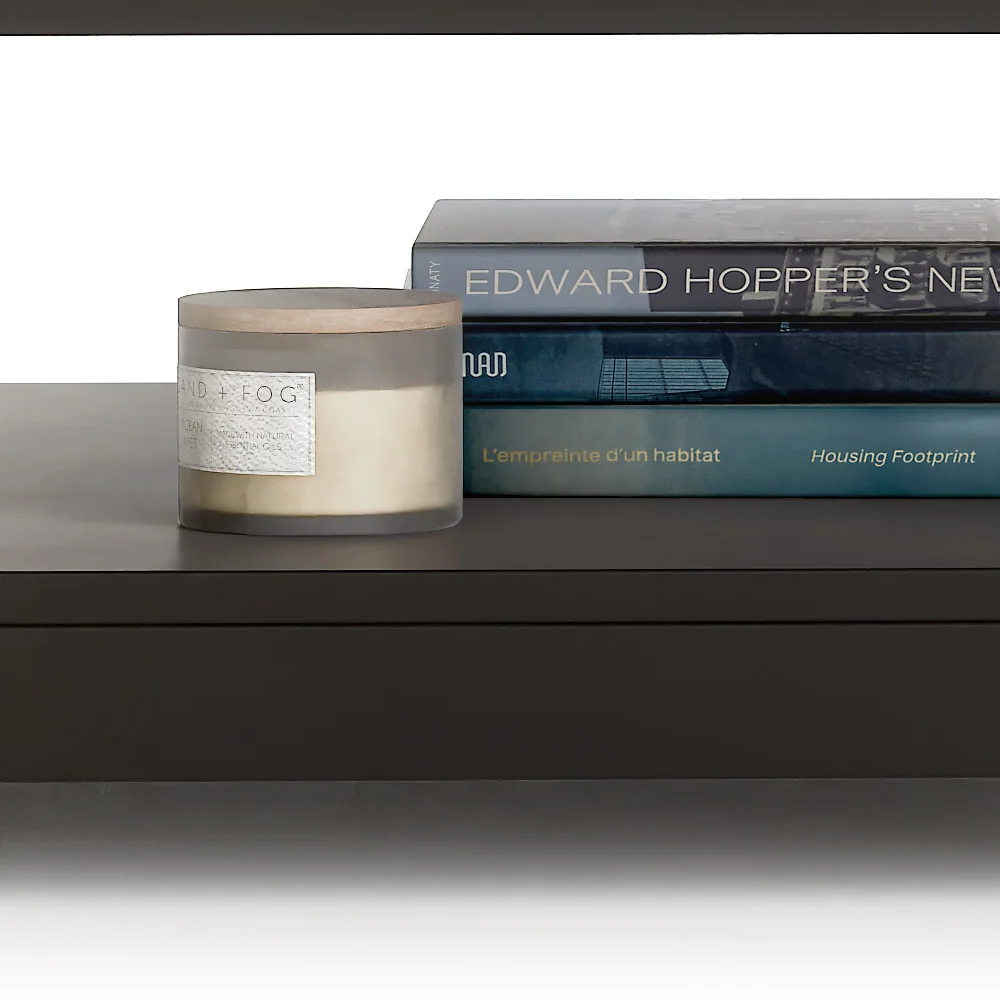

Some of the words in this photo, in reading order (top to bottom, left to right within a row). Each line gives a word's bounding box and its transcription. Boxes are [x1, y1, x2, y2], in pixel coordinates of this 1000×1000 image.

[465, 268, 668, 296] EDWARD
[685, 265, 911, 295] HOPPER'S
[482, 447, 600, 466] L'empreinte
[606, 447, 648, 463] d'un
[653, 447, 721, 463] habitat
[811, 449, 888, 467] Housing
[891, 449, 977, 467] Footprint
